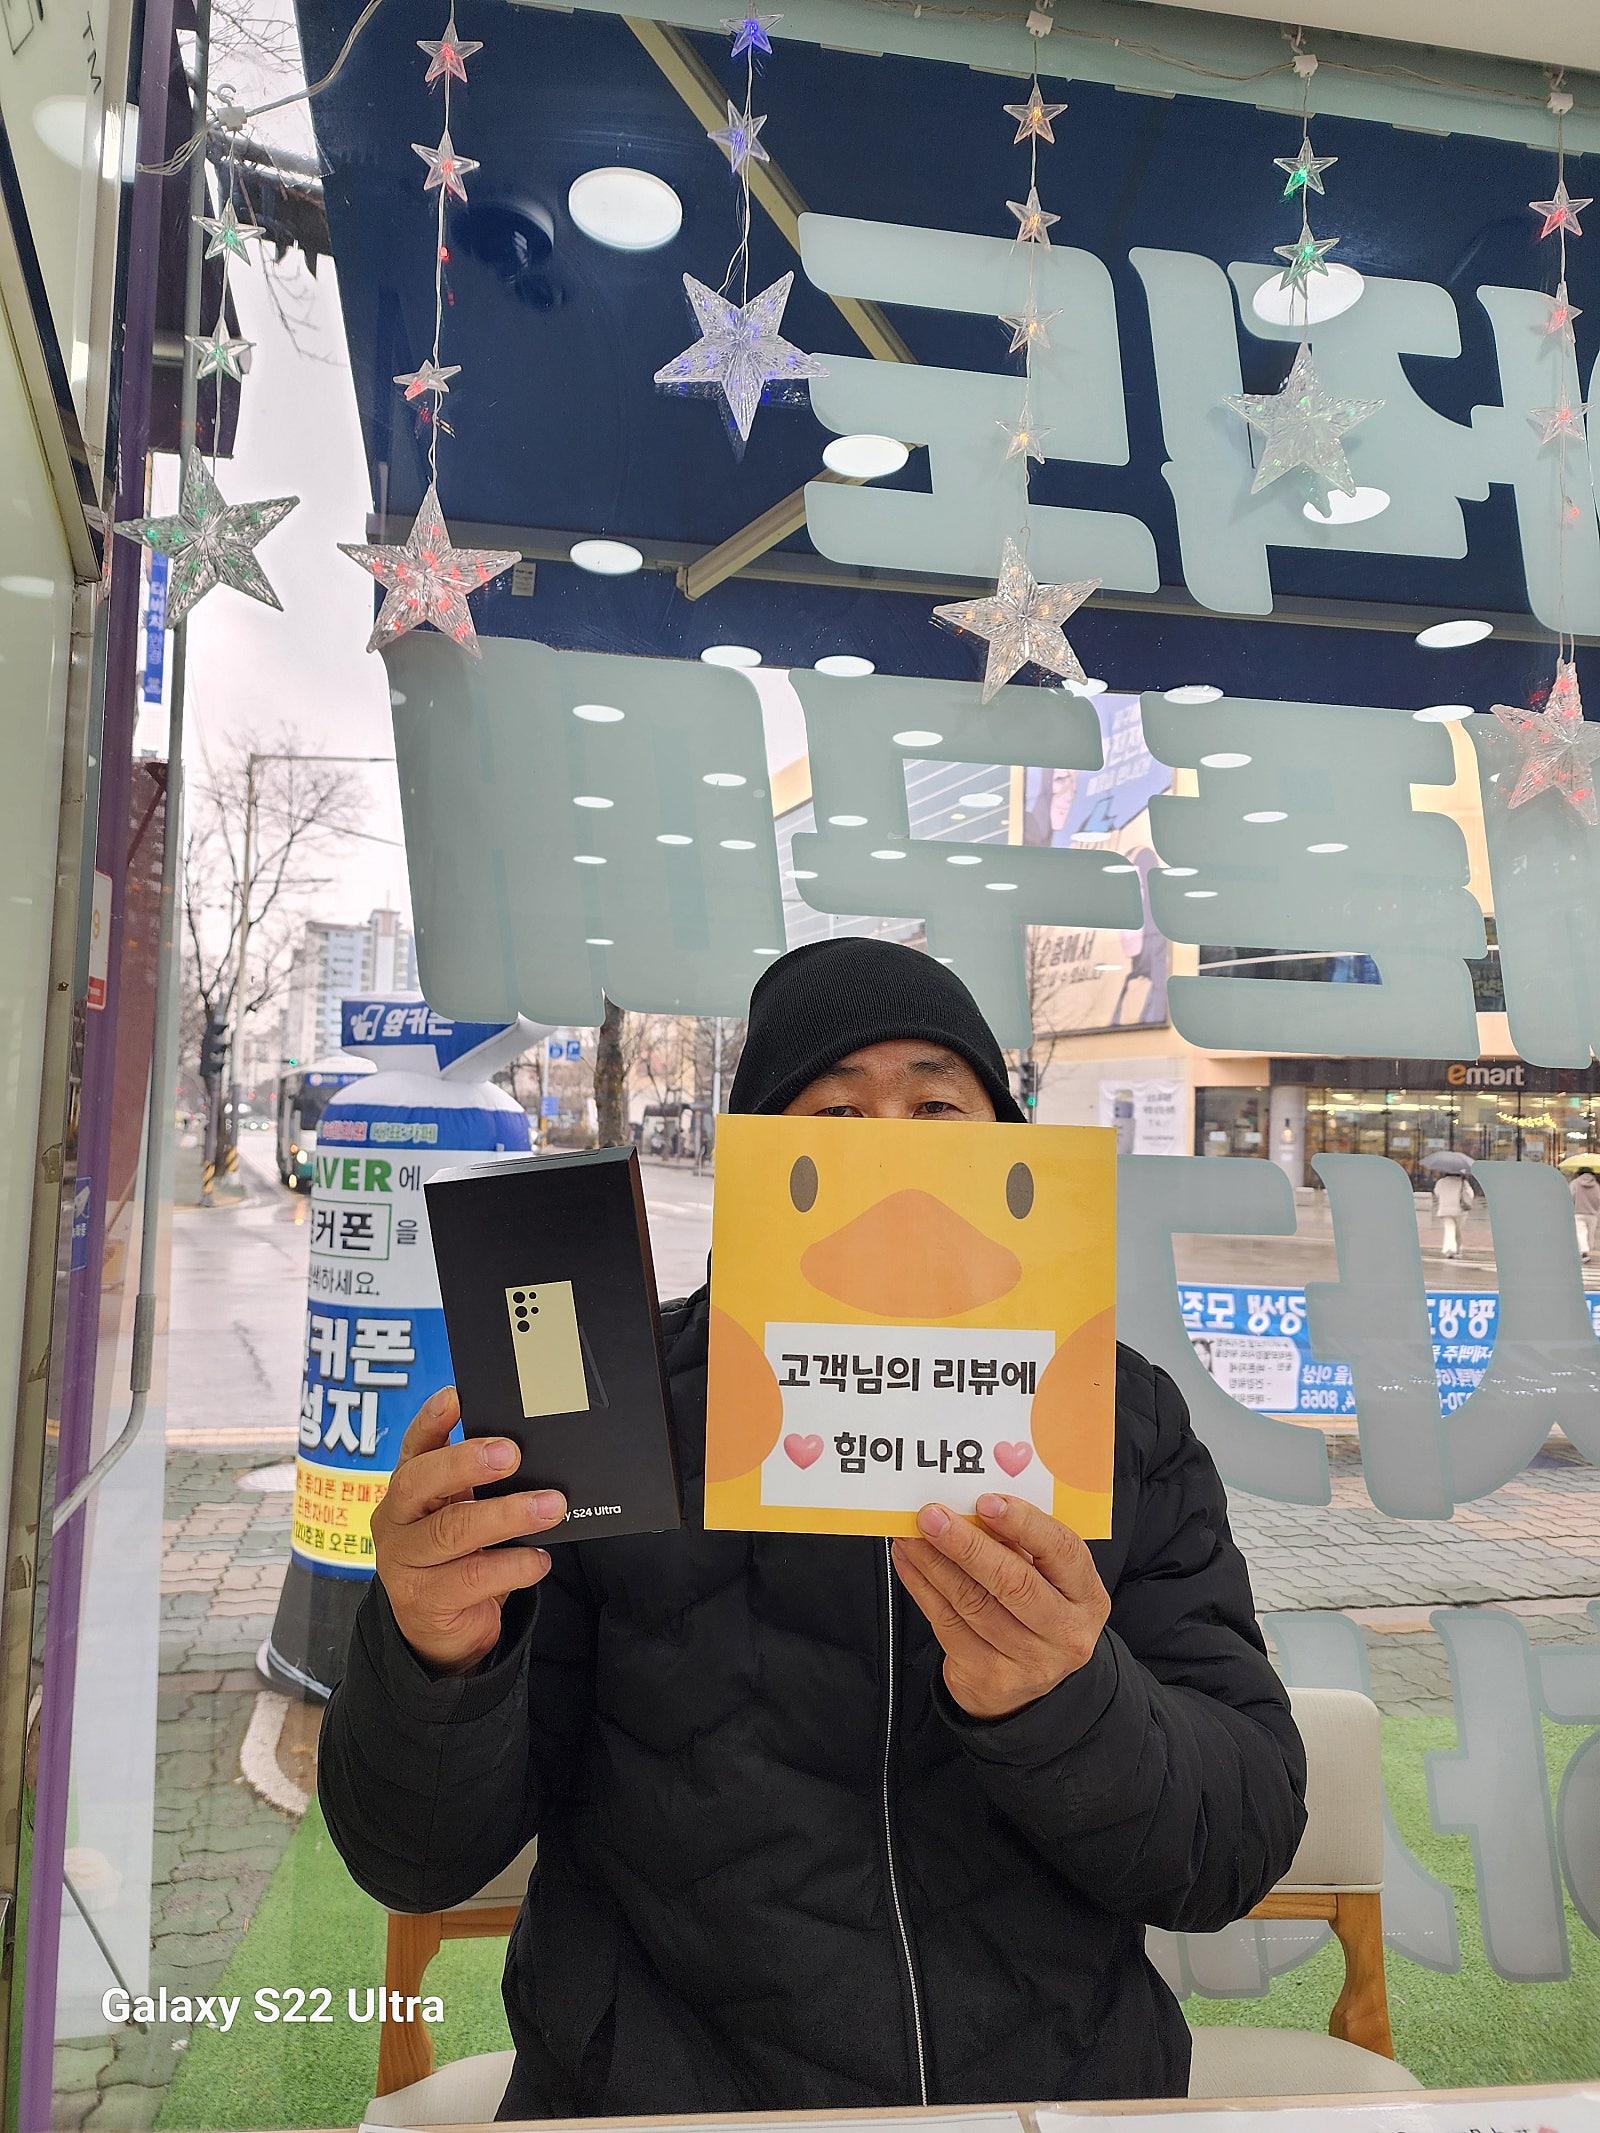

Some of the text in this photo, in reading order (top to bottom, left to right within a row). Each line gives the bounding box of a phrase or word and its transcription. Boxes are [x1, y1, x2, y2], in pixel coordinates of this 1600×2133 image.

[1447, 1064, 1526, 1087] emart
[399, 1165, 421, 1191] 에
[311, 1210, 419, 1251] 커폰 을
[304, 1311, 416, 1387] 커폰
[778, 1354, 1037, 1396] 고객님의 리뷰에
[301, 1380, 379, 1455] 성지
[833, 1431, 986, 1475] 힘이 나요
[573, 1507, 593, 1518] S24
[594, 1505, 622, 1516] Ultra
